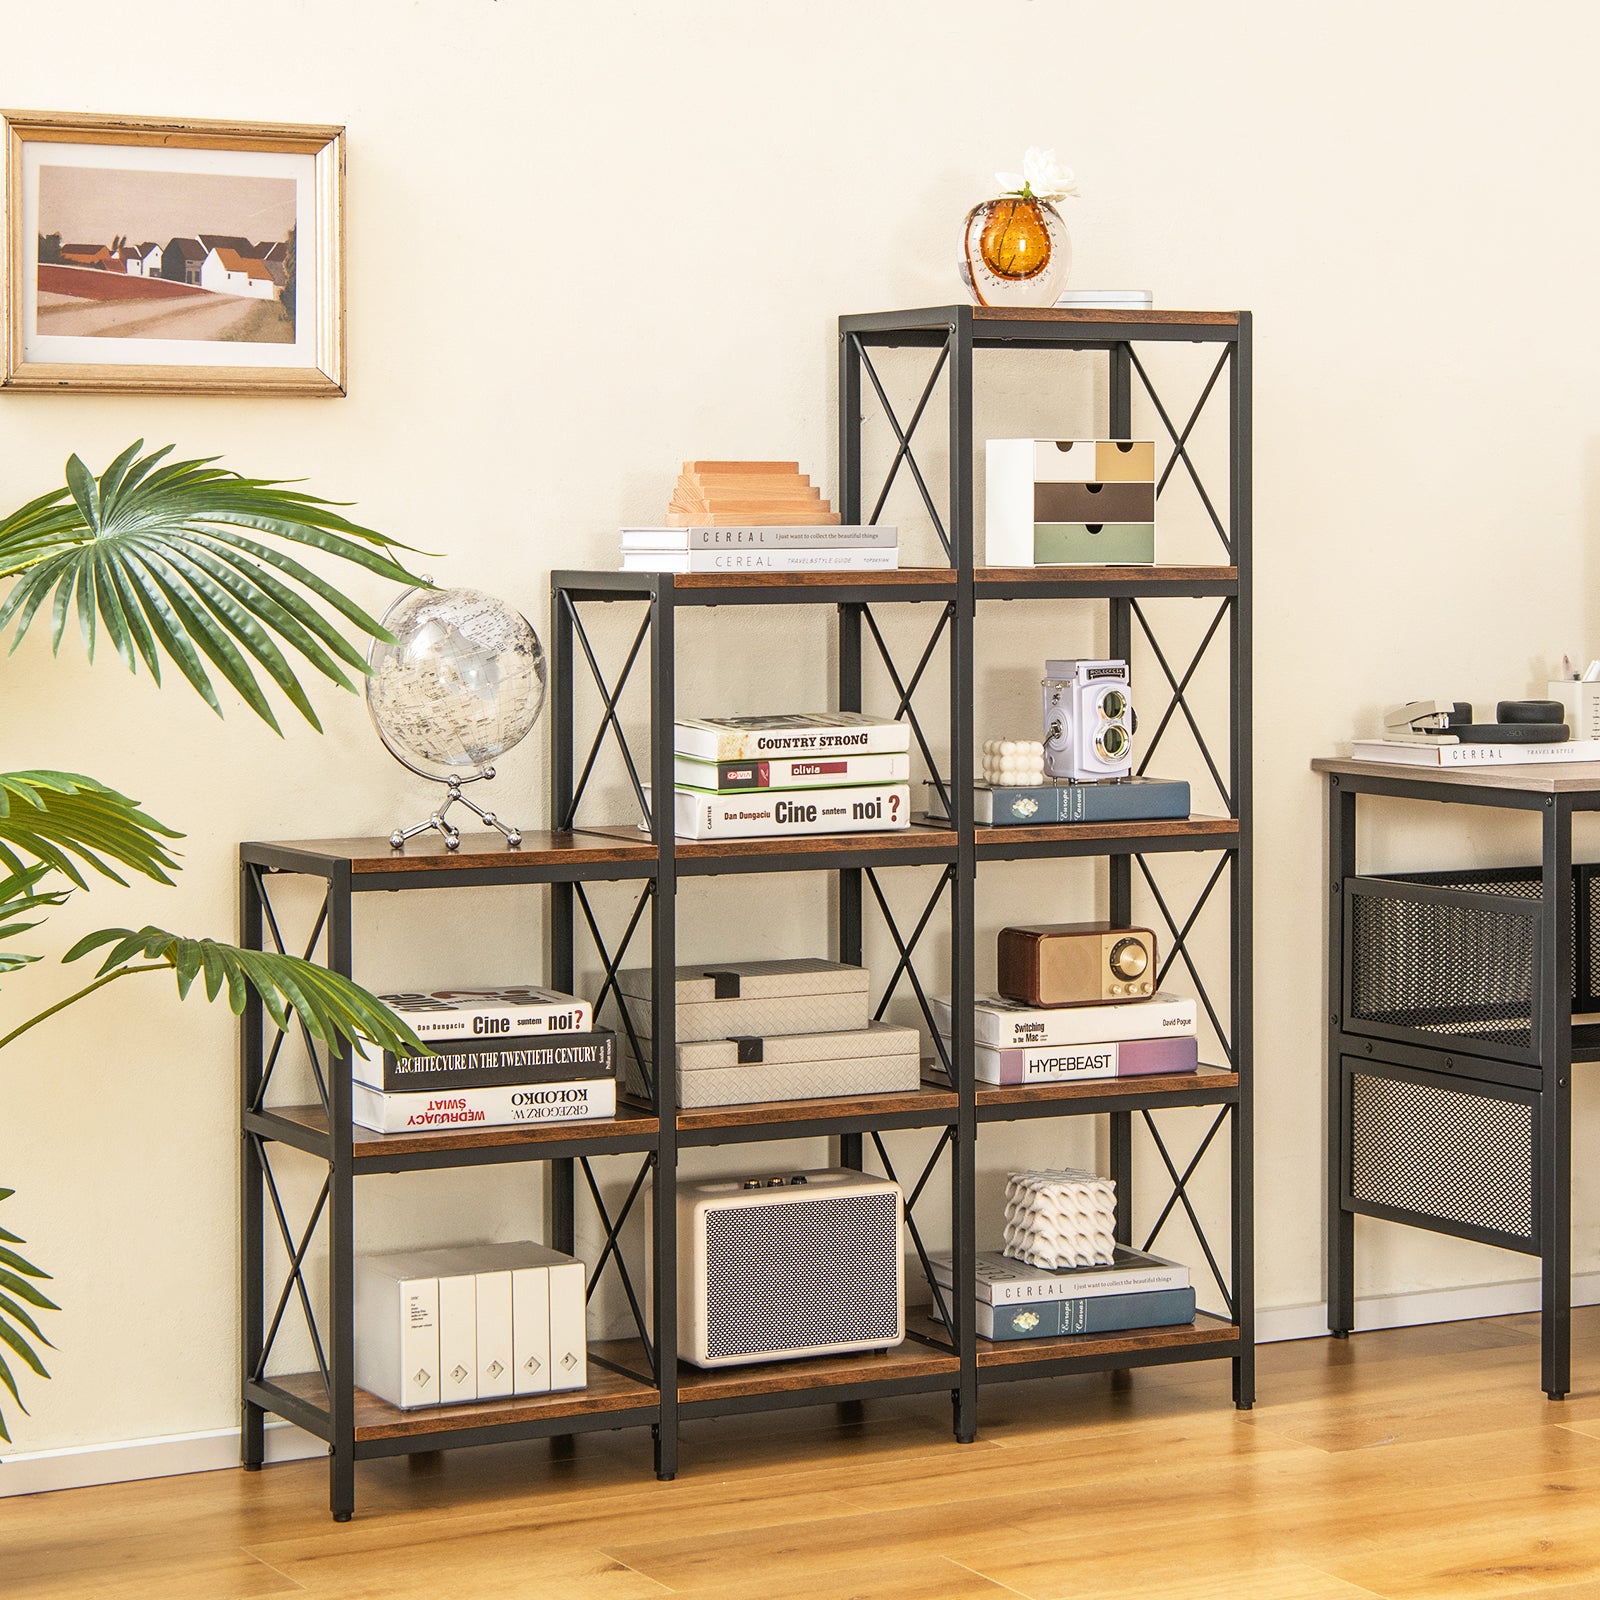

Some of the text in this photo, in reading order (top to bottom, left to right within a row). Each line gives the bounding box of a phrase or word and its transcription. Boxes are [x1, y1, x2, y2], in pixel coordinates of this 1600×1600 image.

[703, 532, 765, 543] CEREAL
[862, 532, 878, 540] things
[715, 556, 772, 567] CEREAL
[758, 733, 868, 750] COUNTRY STRONG
[1452, 749, 1502, 760] CEREAL
[793, 764, 820, 774] olivia
[724, 812, 737, 820] Dan
[739, 810, 771, 820] Dungaciu
[775, 801, 817, 824] Cine
[852, 797, 882, 820] noi
[888, 795, 900, 822] ?
[1060, 789, 1069, 821] Europe
[472, 1016, 510, 1034] Cine
[1014, 1022, 1044, 1033] Switching
[1162, 1018, 1192, 1026] David Pogue
[1026, 1033, 1039, 1042] Mac
[468, 1053, 479, 1069] IN
[480, 1052, 499, 1068] THE
[500, 1048, 554, 1068] TWENTIETH
[555, 1046, 598, 1065] CENTURY
[1030, 1054, 1112, 1074] HYPEBEAST
[427, 1098, 466, 1111] ŚWIAT
[512, 1089, 588, 1106] KOŁODKO
[527, 1104, 589, 1119] GRZEGORZ
[1005, 1284, 1064, 1298] CEREAL
[1061, 1301, 1071, 1333] Europe
